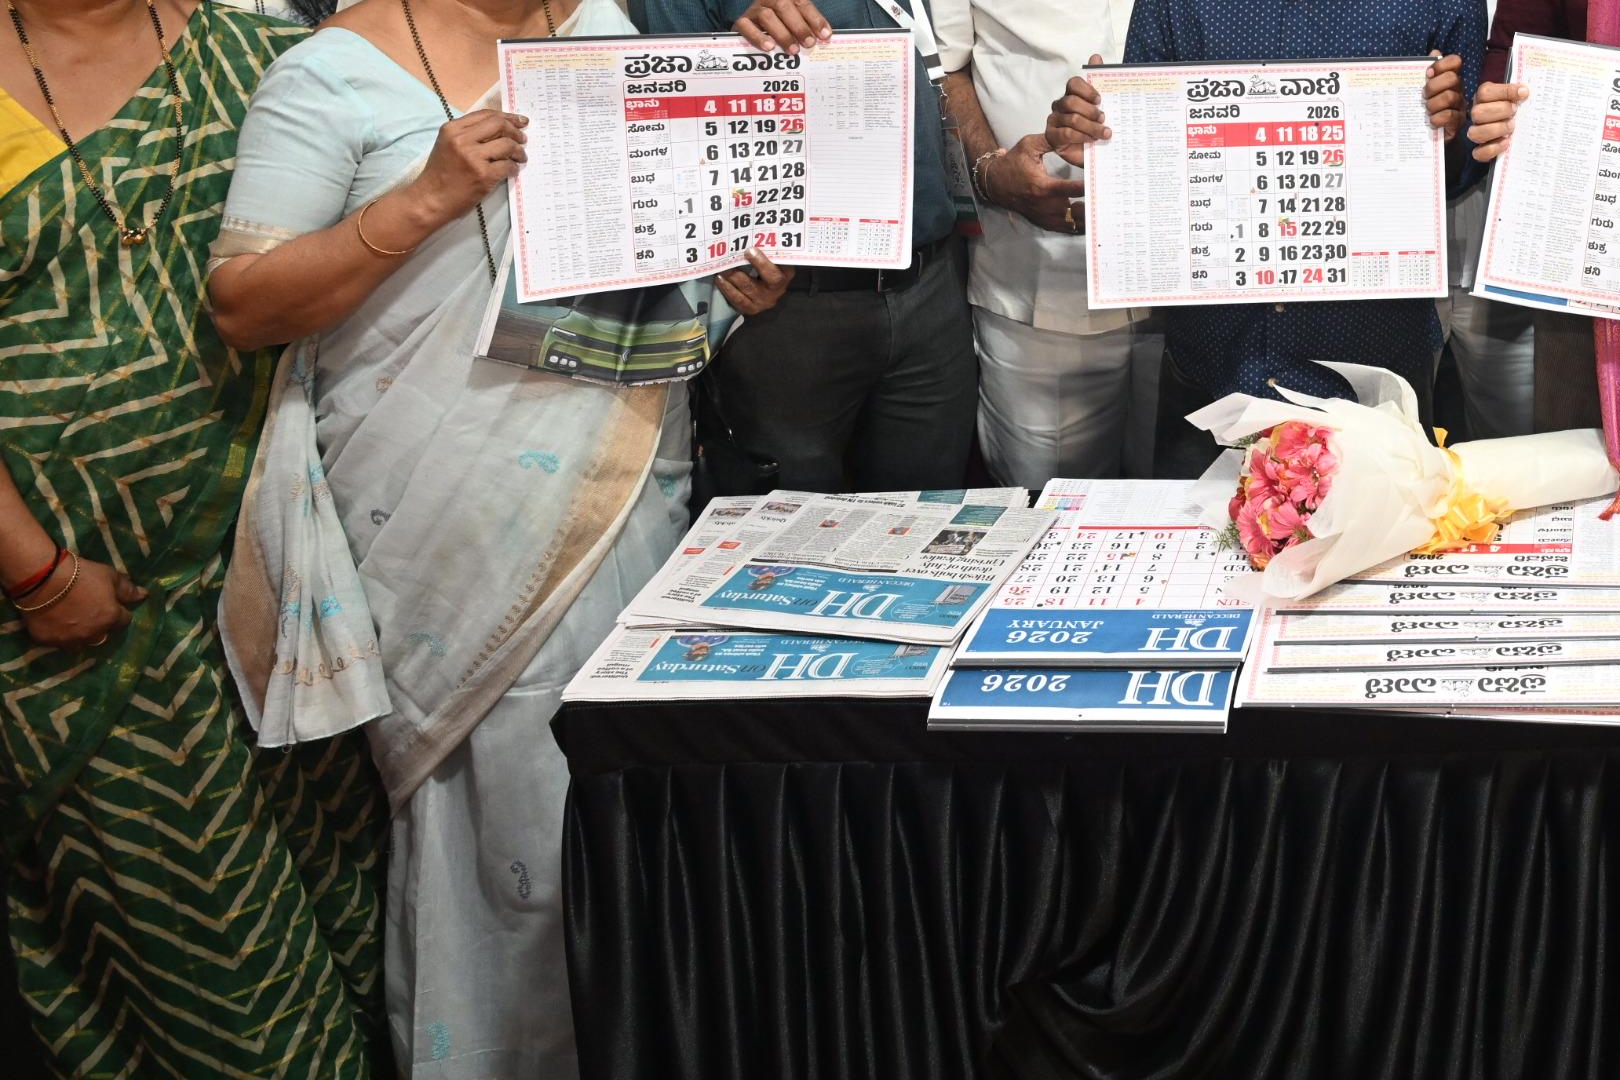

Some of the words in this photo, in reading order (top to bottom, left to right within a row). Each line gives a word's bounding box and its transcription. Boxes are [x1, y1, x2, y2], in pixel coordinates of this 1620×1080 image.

[625, 54, 692, 78] ಪ್ರಜಾ
[628, 80, 686, 94] ಜನವರಿ
[763, 80, 799, 92] 2026
[1187, 79, 1245, 102] ಪ್ರಜಾ
[1280, 72, 1340, 95] ವಾಣಿ
[626, 99, 659, 110] ಭಾನು
[1190, 105, 1240, 118] ಜನವರಿ
[1308, 106, 1339, 118] 2026
[628, 123, 664, 132] ಸೋಮ
[630, 147, 667, 158] ಮಂಗಳ
[631, 173, 654, 183] ಬುಧ
[633, 199, 657, 209] ಗುರು
[635, 224, 656, 235] ಶುಕ್ರ
[636, 250, 654, 259] ಶನಿ
[959, 564, 992, 573] death
[1404, 565, 1469, 578] ವಾಣಿ
[1507, 565, 1568, 578] ಪ್ರಜಾ
[715, 588, 796, 607] Saturday
[1389, 591, 1455, 604] ವಾಣಿ
[1494, 591, 1557, 601] ಪ್ರಜಾ
[806, 589, 902, 620] DH
[1007, 619, 1104, 629] JANUARY
[1391, 621, 1458, 632] ವಾಣಿ
[1497, 618, 1563, 629] ಪ್ರಜಾ
[1006, 630, 1092, 644] 2026
[1138, 626, 1237, 650] DH
[1386, 648, 1456, 662] ವಾಣಿ
[1495, 643, 1562, 656] ಪ್ರಜಾ
[647, 660, 741, 675] Saturday
[756, 652, 858, 680] DH
[981, 674, 1071, 692] 2026
[1118, 671, 1219, 706] DH
[1364, 677, 1437, 698] ವಾಣಿ
[1478, 675, 1546, 695] ಪ್ರಜಾ
